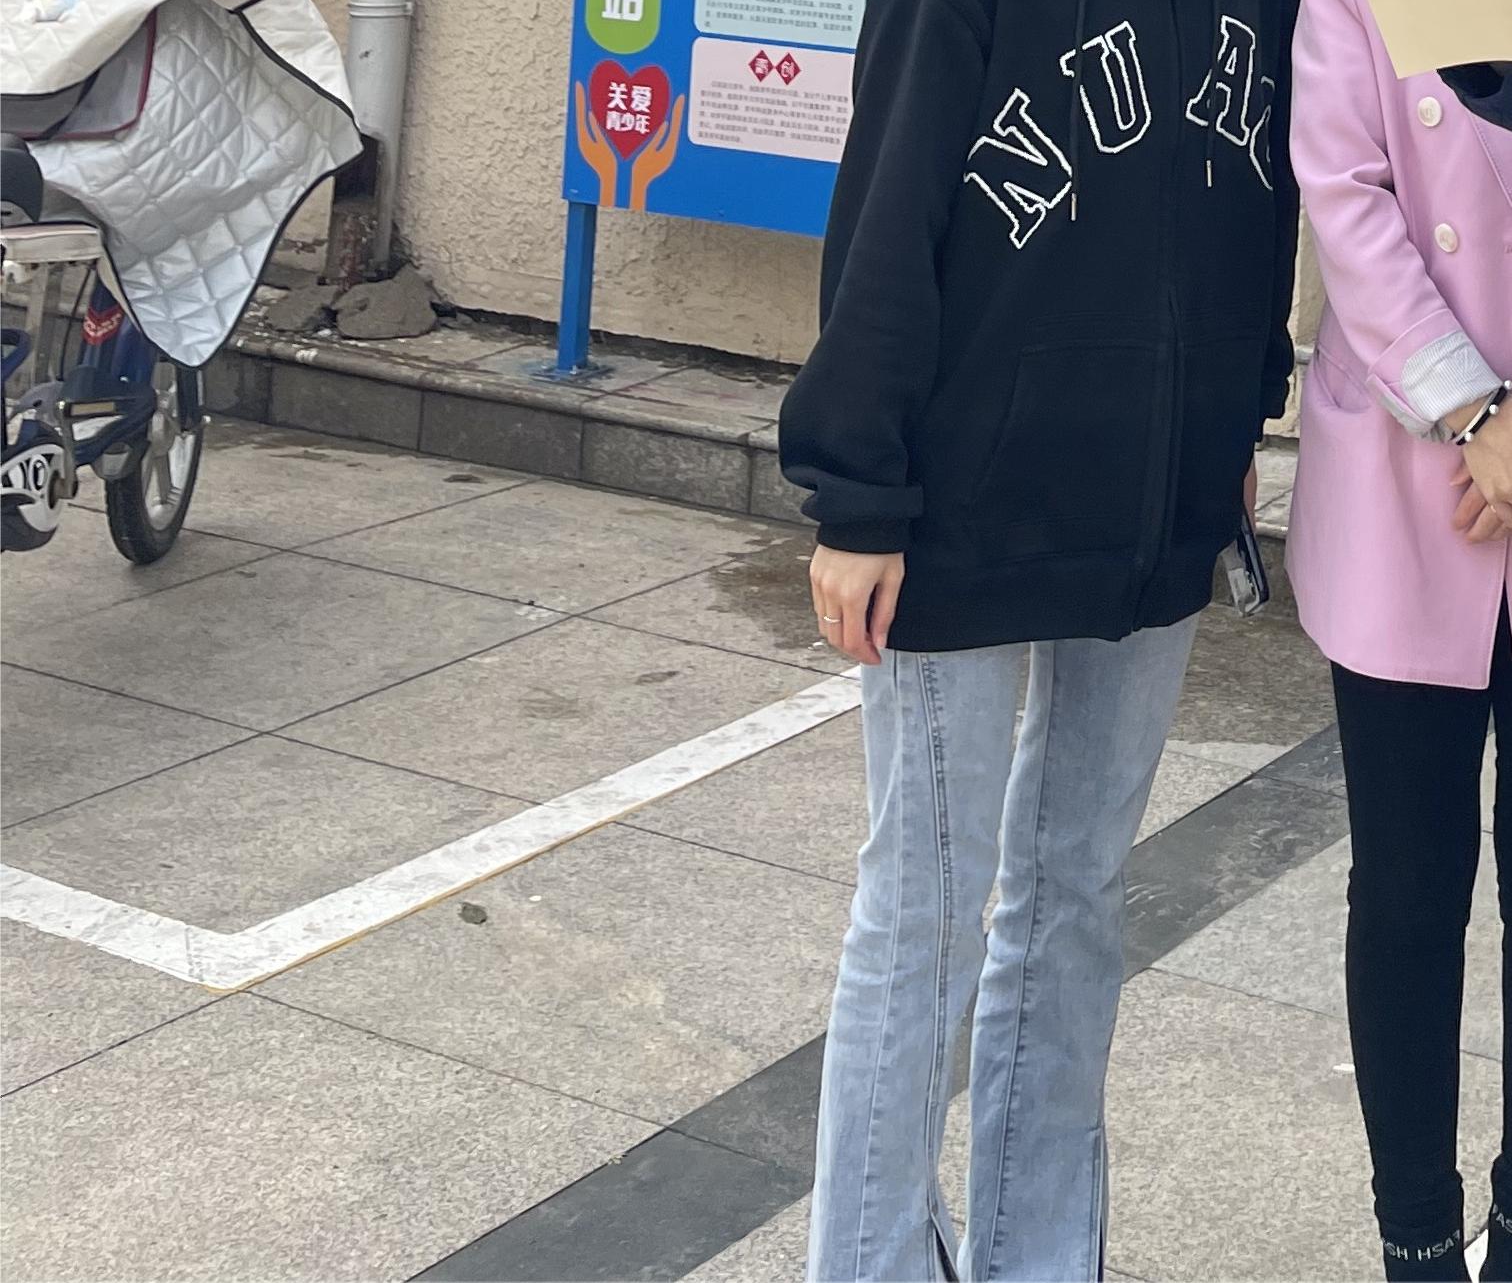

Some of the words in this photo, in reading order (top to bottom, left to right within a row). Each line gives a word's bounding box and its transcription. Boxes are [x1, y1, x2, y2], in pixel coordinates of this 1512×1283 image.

[606, 81, 653, 113] 关爱
[604, 109, 652, 136] 青少年
